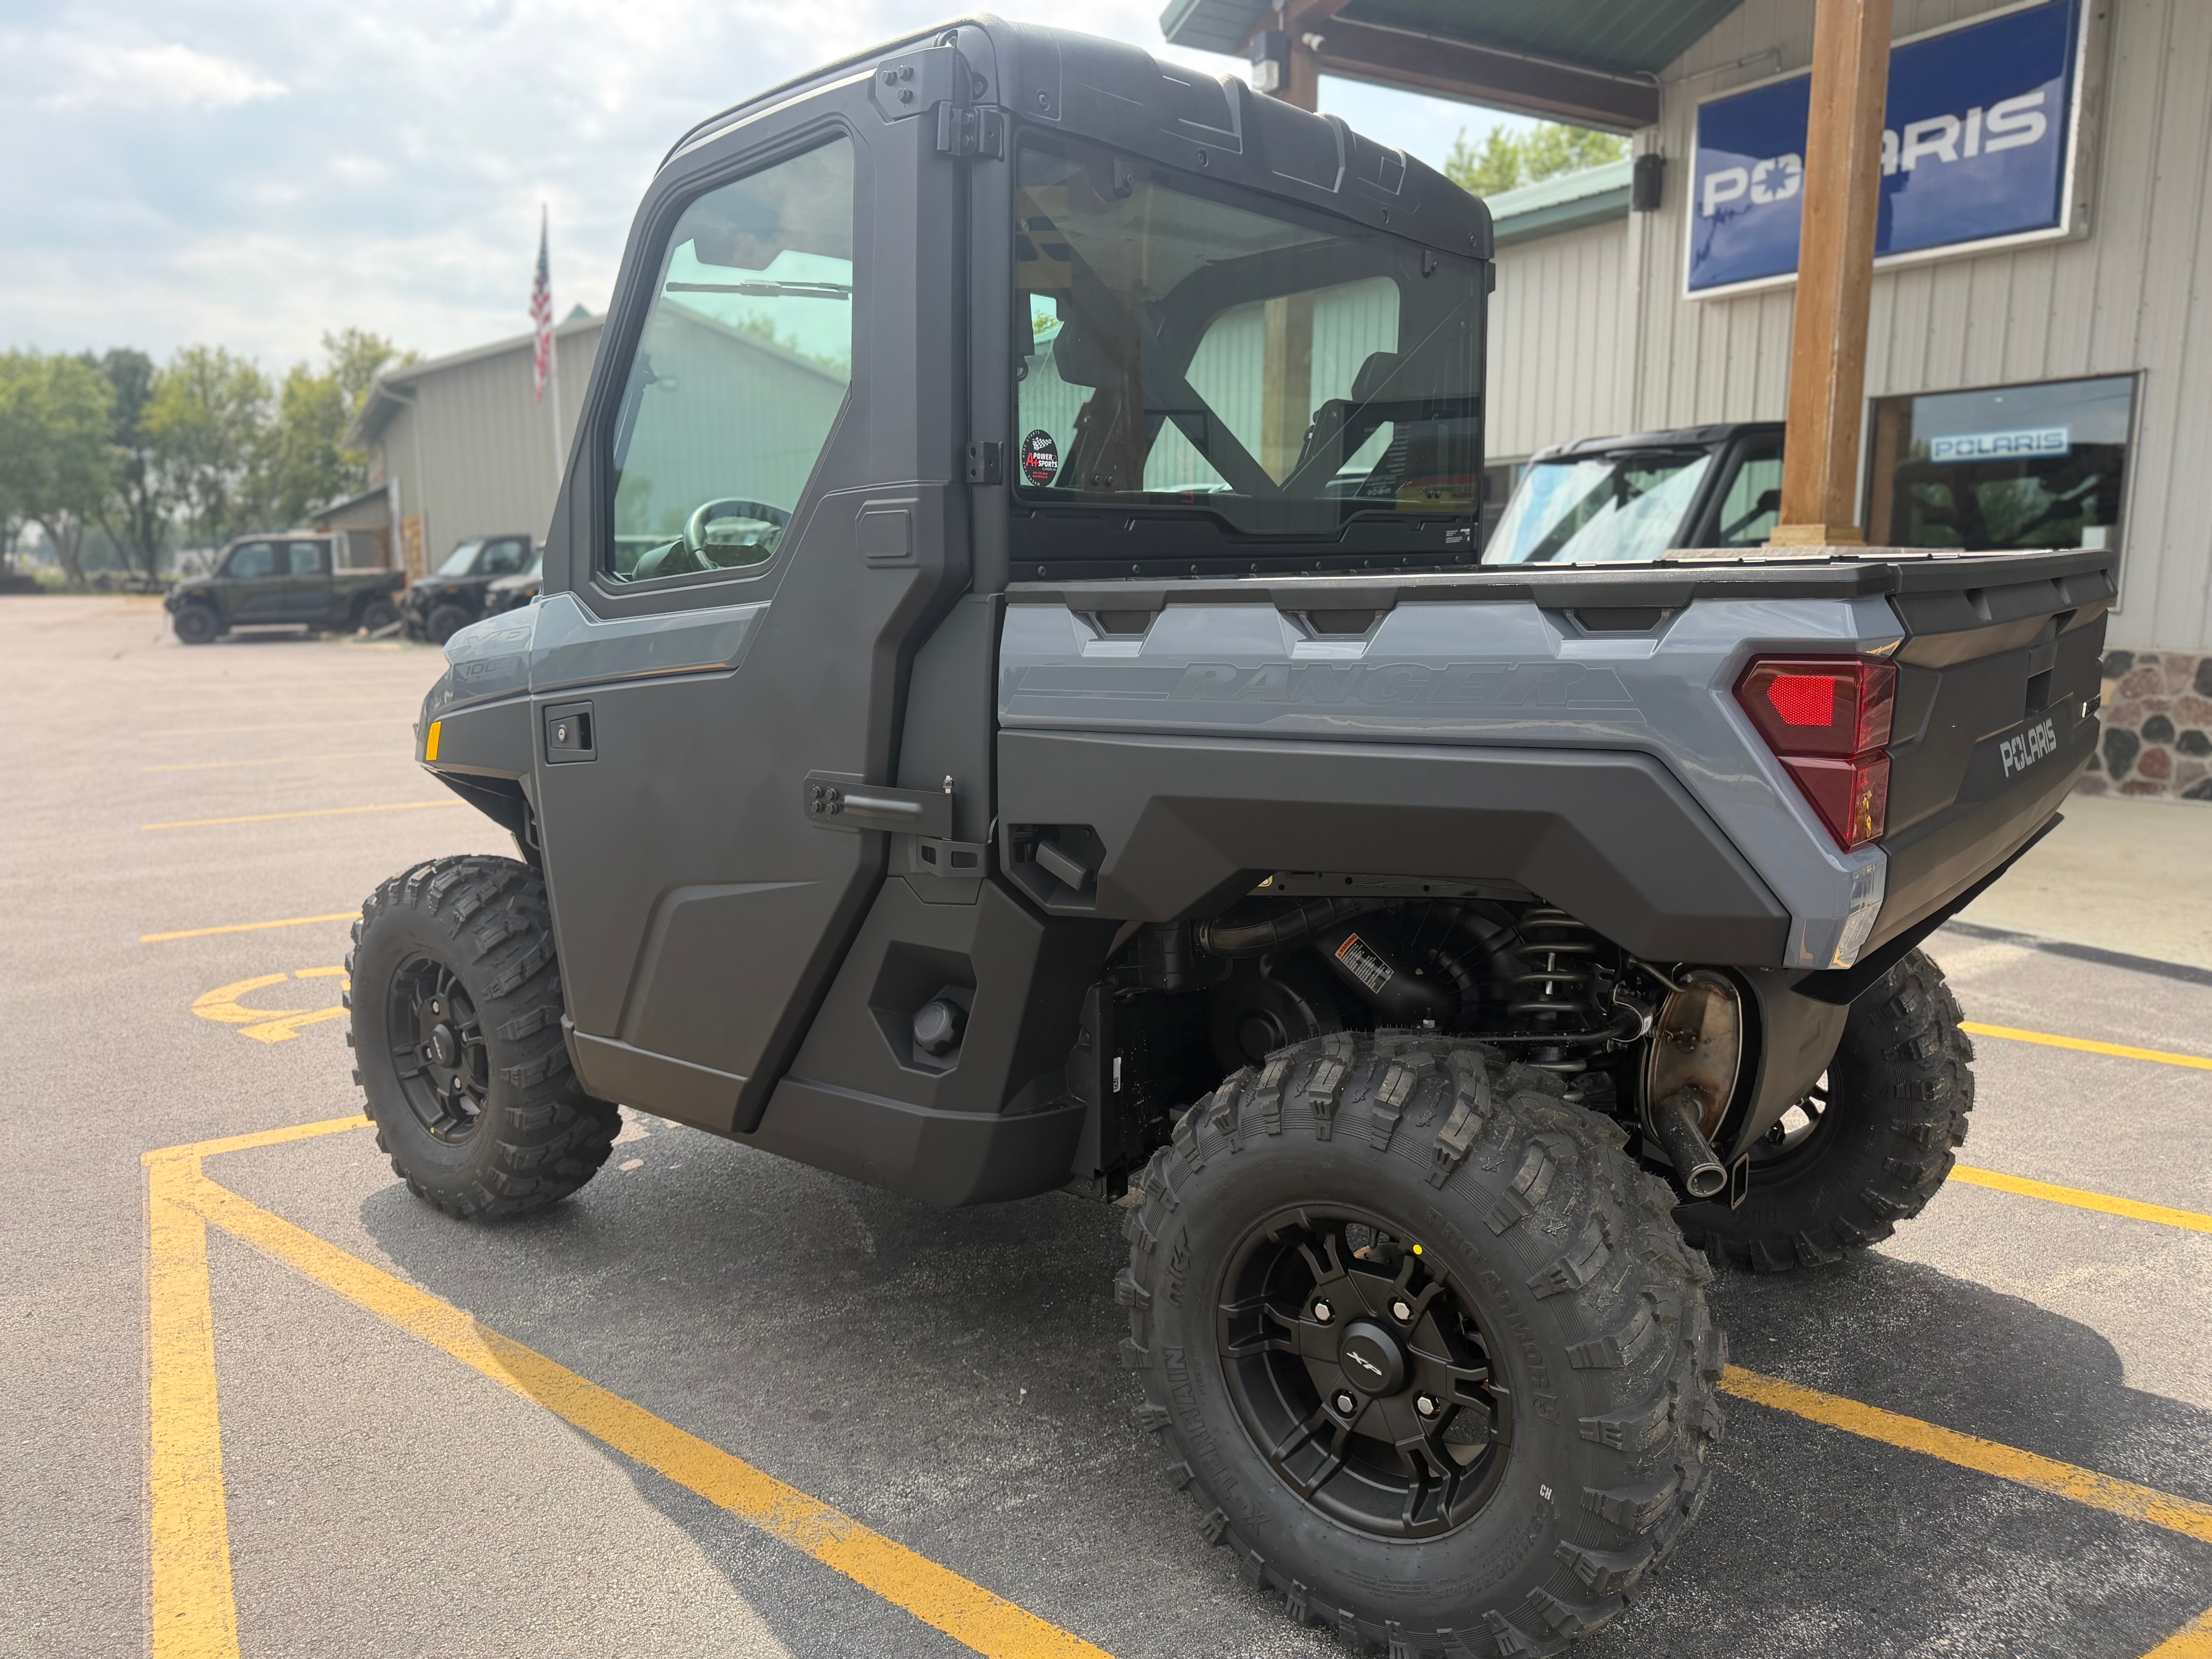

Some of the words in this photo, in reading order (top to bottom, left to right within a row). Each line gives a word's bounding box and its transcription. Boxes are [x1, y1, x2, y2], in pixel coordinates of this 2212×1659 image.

[1703, 91, 2047, 218] PORIS
[1026, 430, 1040, 442] STARTS
[1935, 432, 2064, 457] POLARIS
[1026, 452, 1039, 467] A+
[1033, 452, 1053, 460] POWER
[461, 625, 532, 656] XP
[1171, 662, 1586, 706] RANGER
[1999, 718, 2057, 778] POLARIS
[1340, 934, 1357, 954] WARNING
[1425, 1207, 1480, 1265] PRO
[1477, 1269, 1549, 1389] ARMOR
[1346, 1351, 1382, 1376] XP
[1164, 1347, 1271, 1537] X-TERRAIN
[1540, 1484, 1553, 1500] CH
